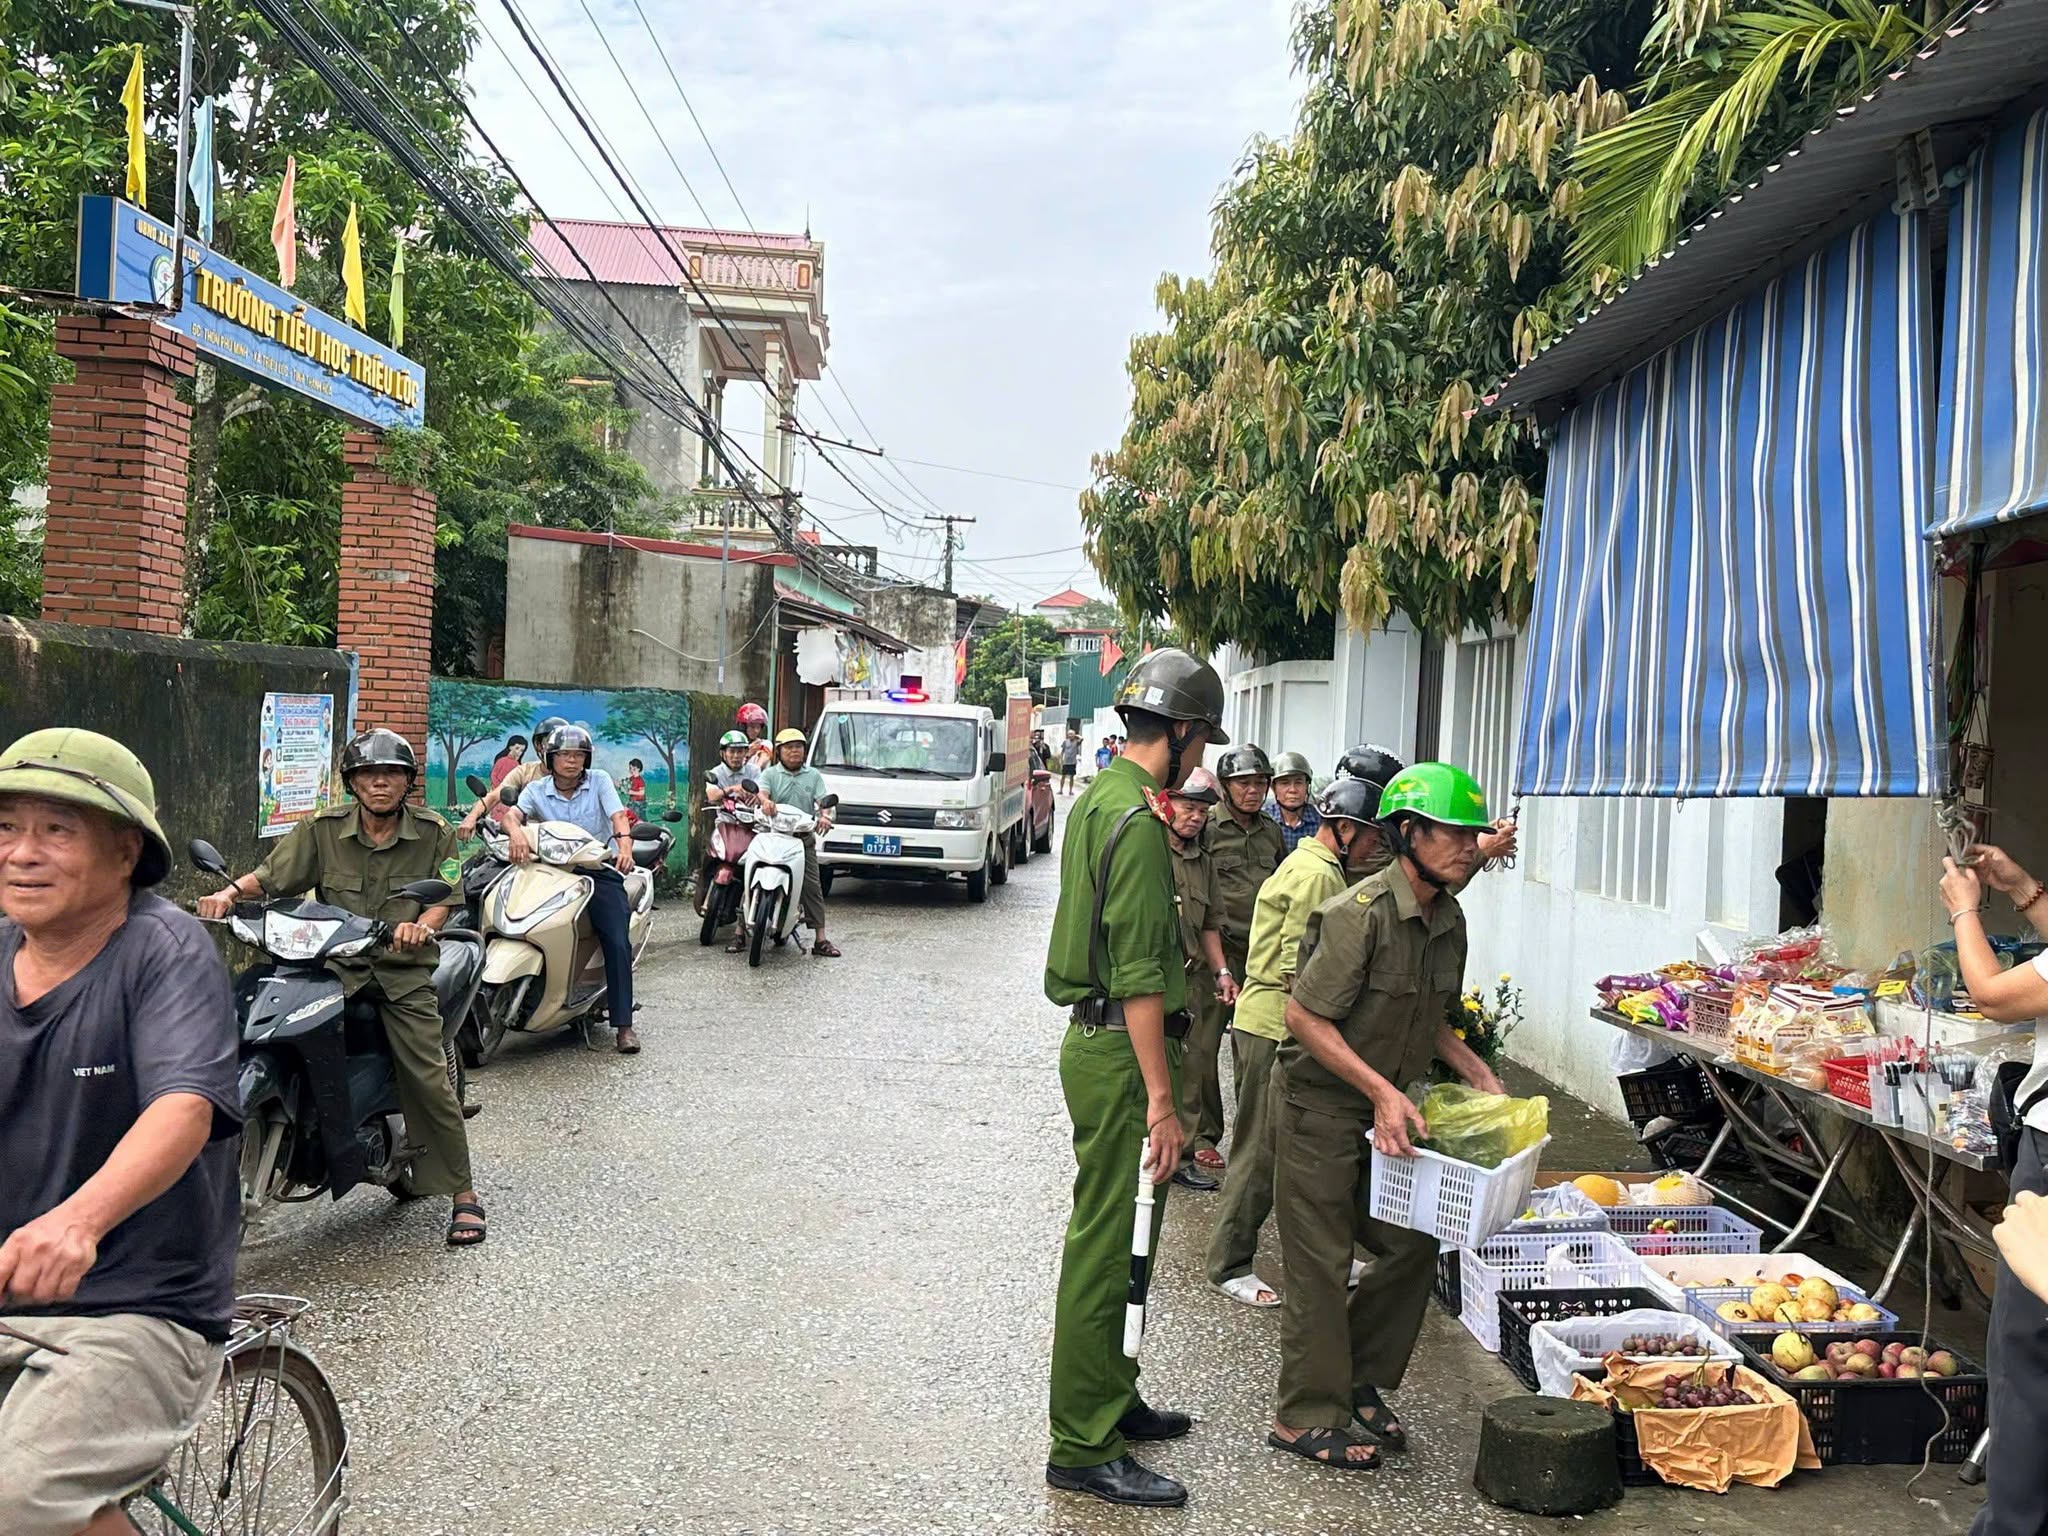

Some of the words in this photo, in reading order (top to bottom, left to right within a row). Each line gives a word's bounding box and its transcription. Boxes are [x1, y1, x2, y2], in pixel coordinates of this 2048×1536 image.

[199, 267, 276, 339] TRƯỜNG
[279, 303, 316, 358] TIỂU
[320, 331, 350, 376] HỌC
[355, 349, 393, 398] TRIỆU
[396, 369, 419, 410] LỘC
[873, 835, 890, 845] 36A
[866, 843, 897, 854] 017.67
[93, 1064, 115, 1076] NAM
